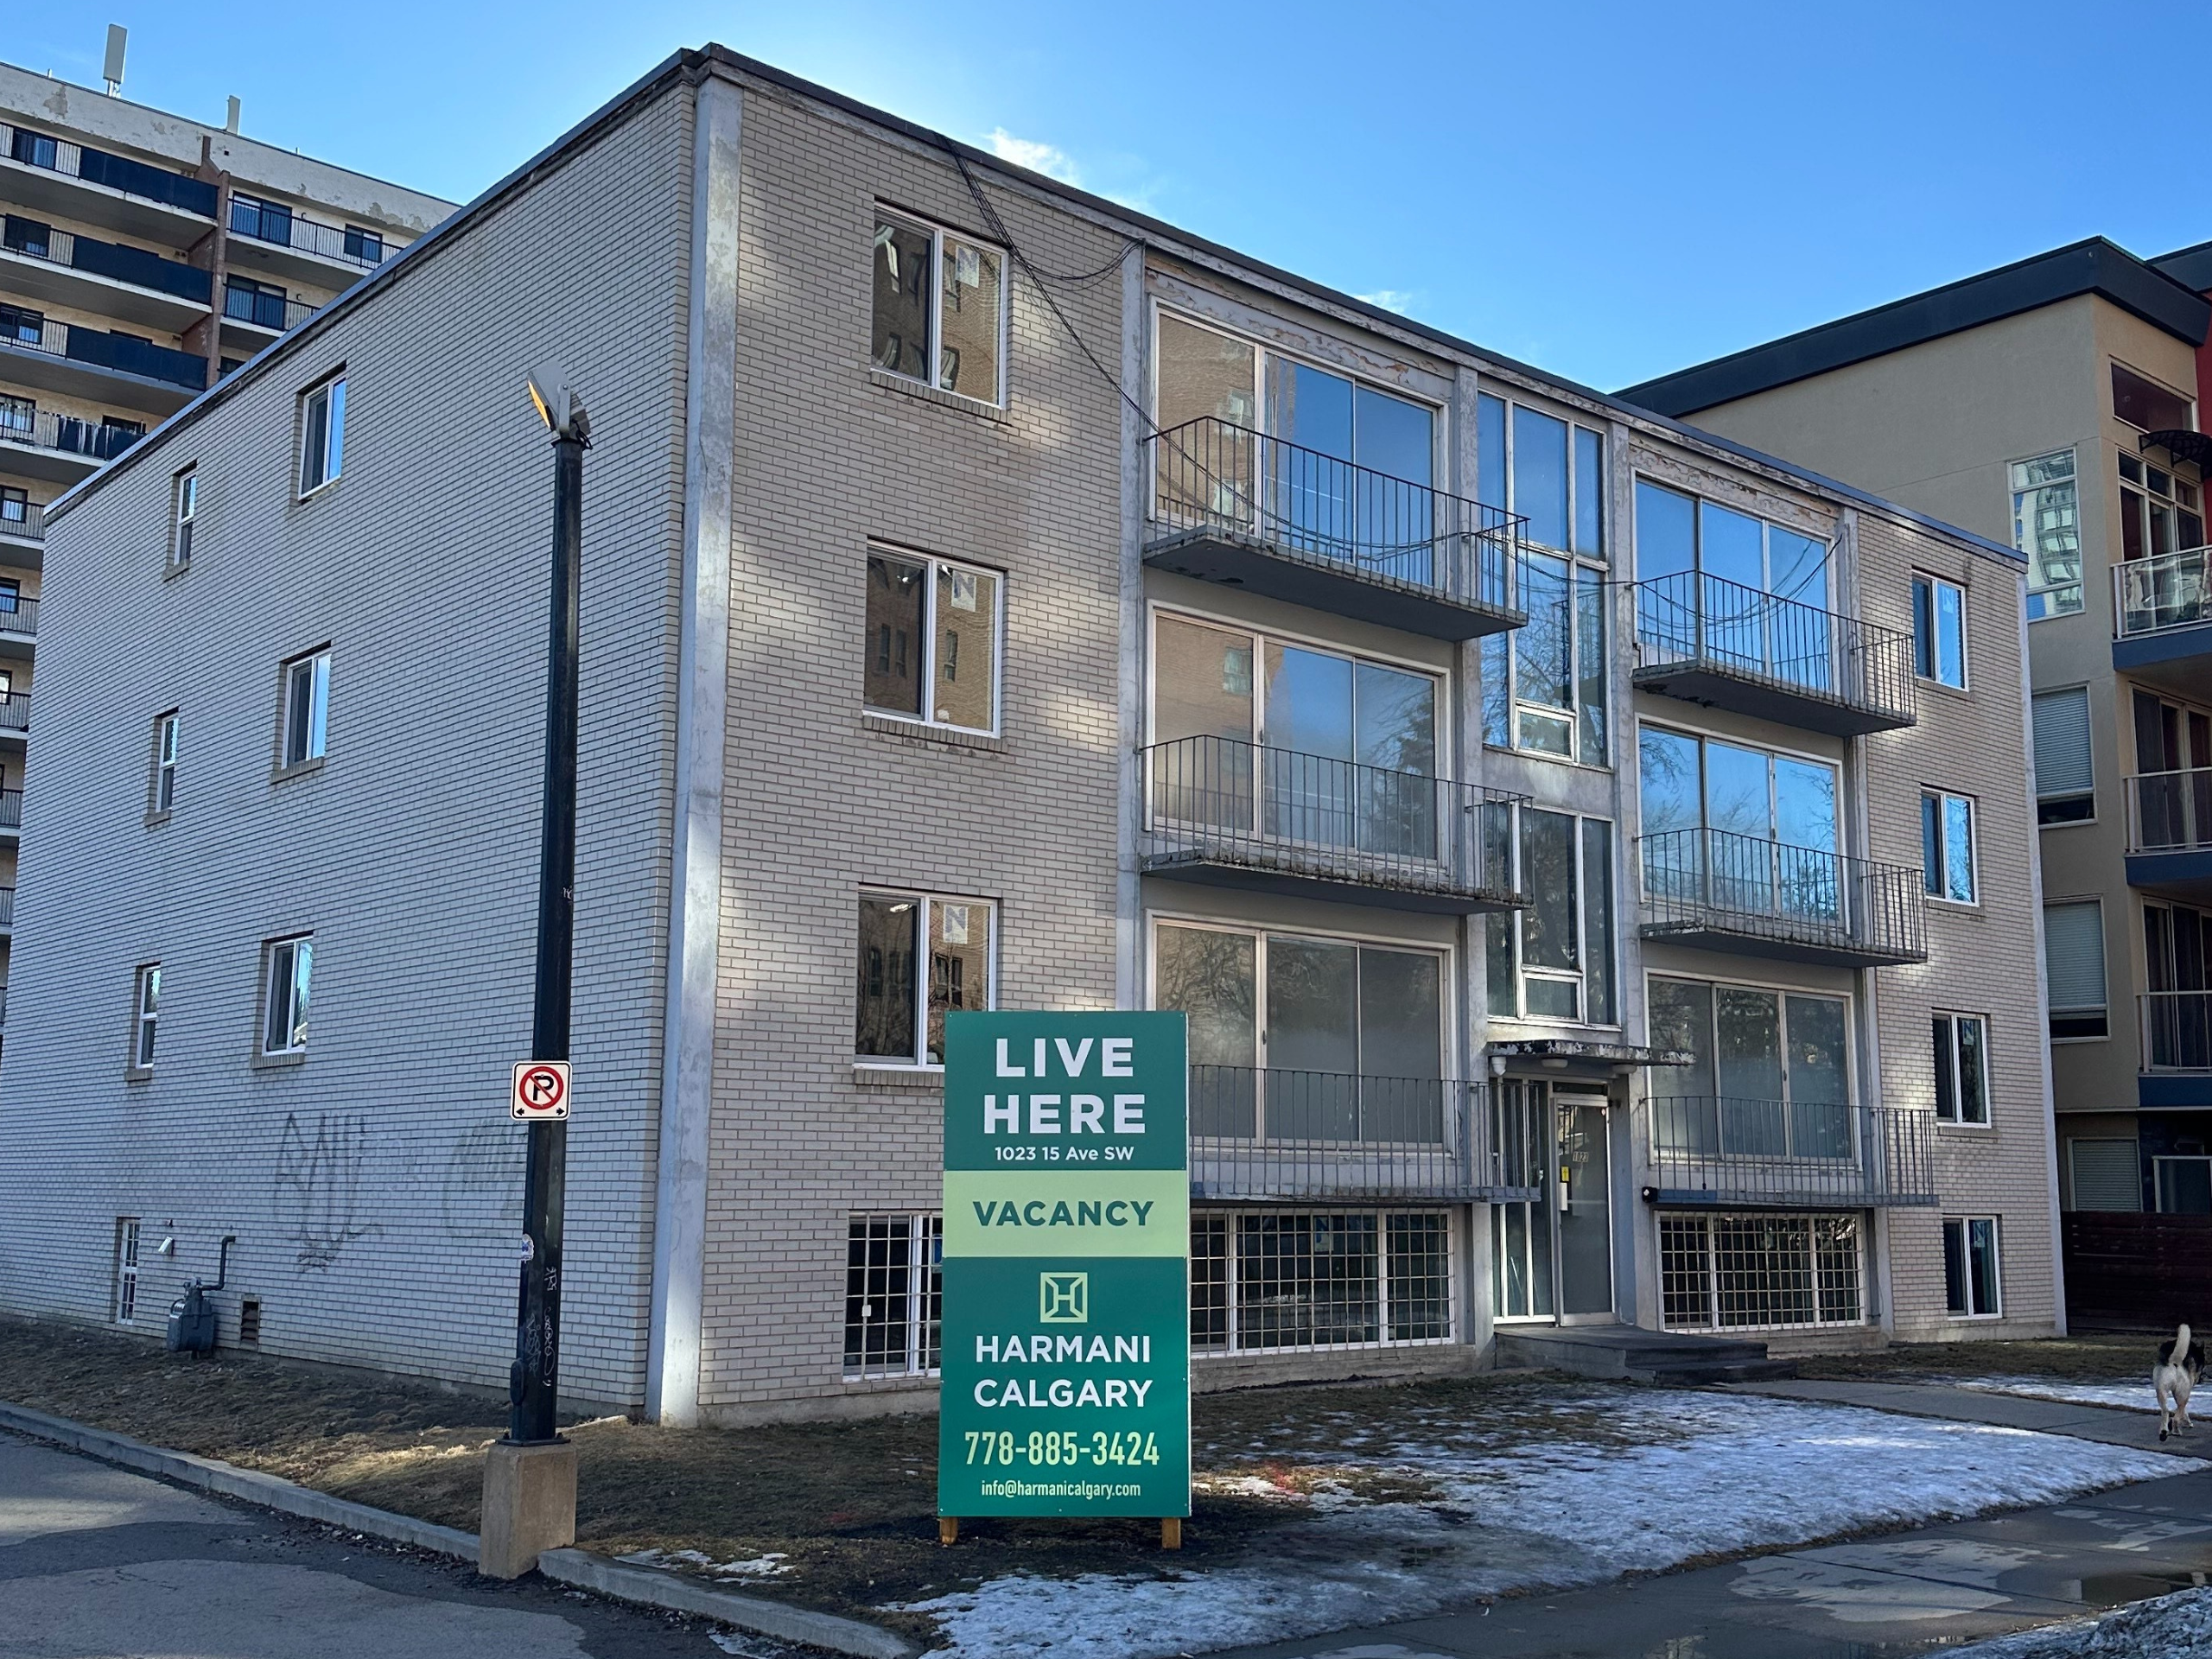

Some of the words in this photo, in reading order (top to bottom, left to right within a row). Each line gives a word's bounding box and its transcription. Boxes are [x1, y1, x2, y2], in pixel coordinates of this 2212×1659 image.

[945, 906, 966, 932] N
[996, 1038, 1134, 1077] LIVE
[533, 1075, 555, 1102] P
[984, 1094, 1146, 1134] HERE
[995, 1147, 1037, 1161] 1023
[1041, 1147, 1060, 1161] 15
[1065, 1147, 1099, 1160] Ave
[1104, 1146, 1135, 1160] SW
[1573, 1152, 1588, 1162] 1023
[973, 1200, 1154, 1227] VACANCY
[976, 1335, 1150, 1363] HARMANI
[973, 1379, 1153, 1408] CALGARY
[964, 1431, 1160, 1465] 778-885-3424
[981, 1479, 1141, 1500] info@harmanicalgary.com
